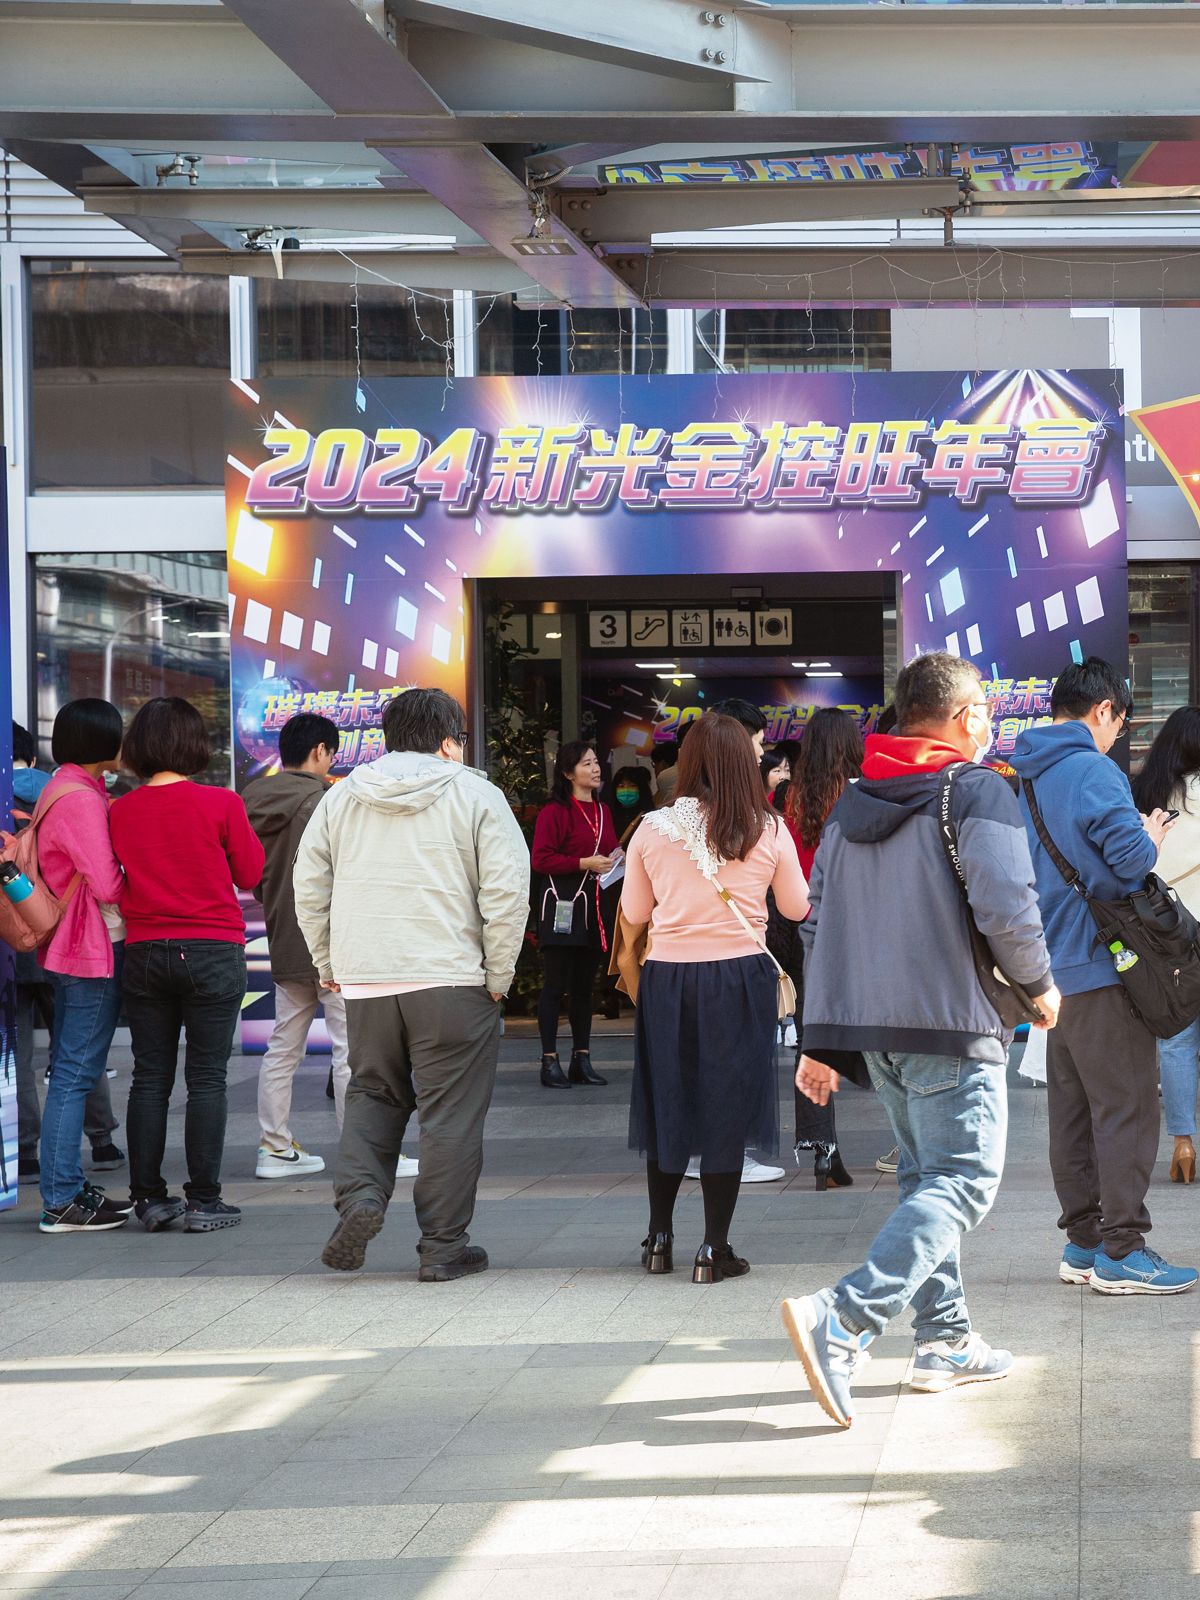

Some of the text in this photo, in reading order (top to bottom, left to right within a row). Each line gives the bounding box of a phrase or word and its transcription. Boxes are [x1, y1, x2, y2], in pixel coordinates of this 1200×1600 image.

[245, 417, 1106, 512] 2024新光金控旺年會
[599, 614, 617, 639] 3
[941, 784, 951, 821] SWOOSH
